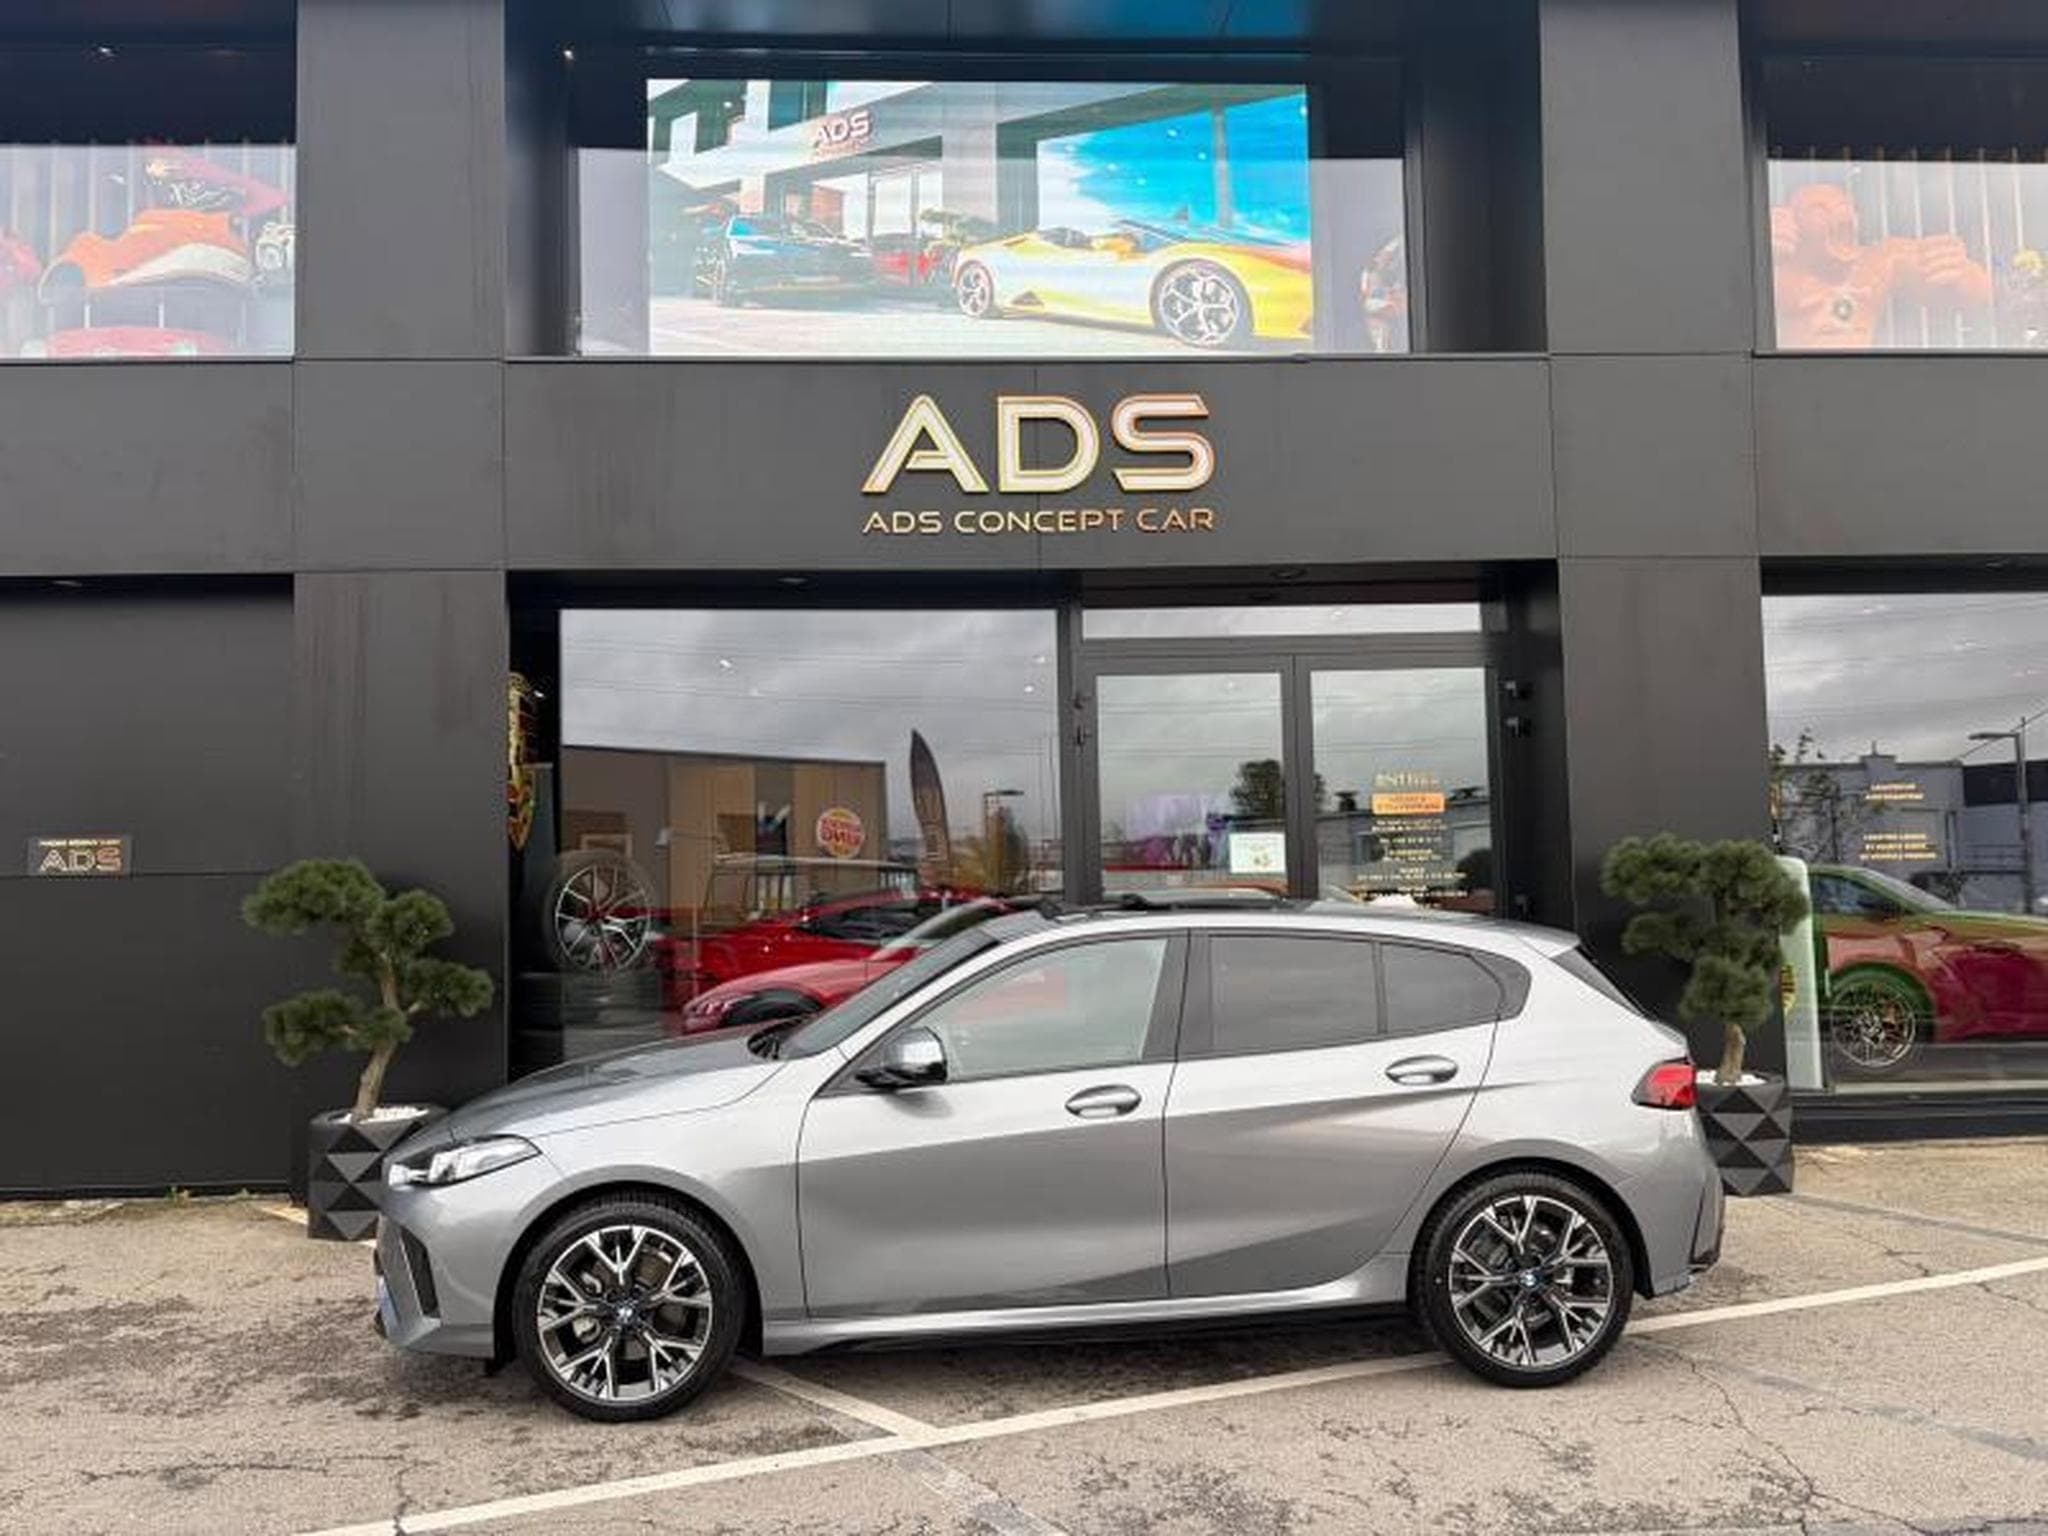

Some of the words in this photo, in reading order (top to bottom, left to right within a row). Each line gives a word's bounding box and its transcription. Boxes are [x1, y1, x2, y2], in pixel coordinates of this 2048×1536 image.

[813, 110, 870, 146] ADS
[861, 393, 1214, 493] ADS
[862, 511, 942, 534] ADS
[954, 509, 1123, 533] CONCEPT
[1136, 508, 1214, 532] CAR
[39, 848, 122, 872] ADS
